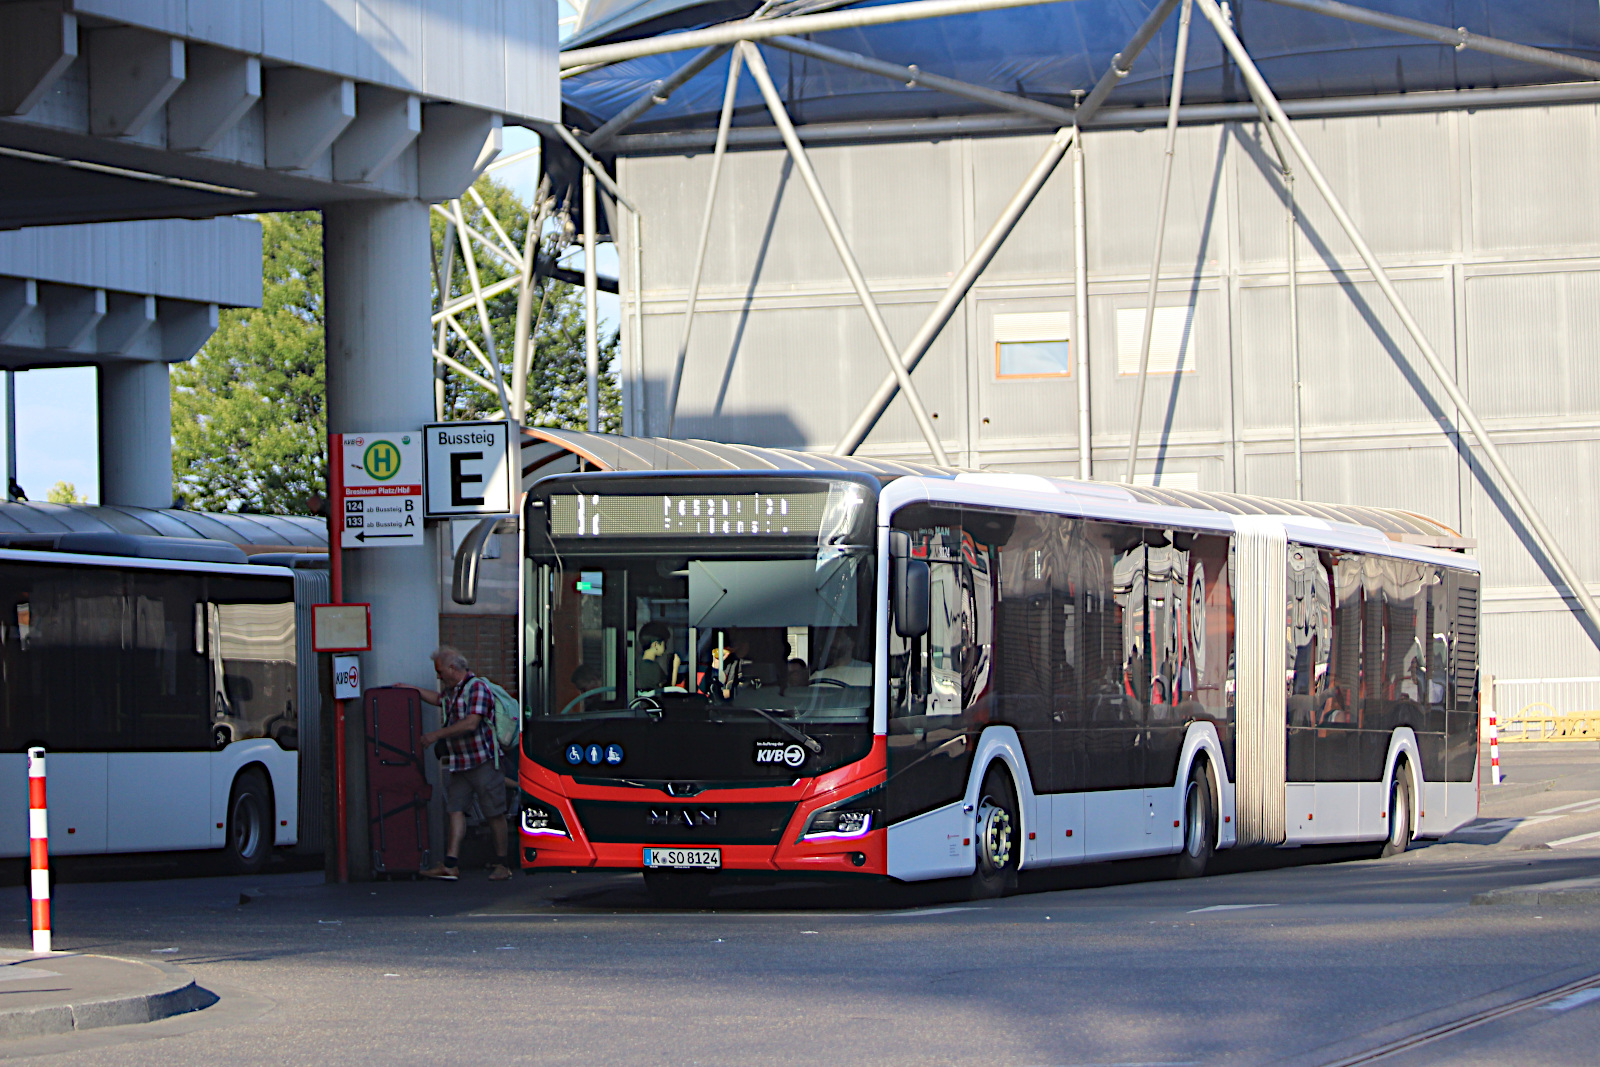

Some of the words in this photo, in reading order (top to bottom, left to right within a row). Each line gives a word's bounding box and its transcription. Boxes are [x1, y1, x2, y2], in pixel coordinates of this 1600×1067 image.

[438, 429, 495, 447] Bussteig
[373, 447, 391, 473] H
[450, 451, 484, 506] E
[345, 488, 377, 496] Breslauer
[346, 502, 363, 511] 124
[405, 499, 414, 512] B
[347, 517, 363, 526] 133
[404, 514, 415, 527] A
[935, 526, 950, 536] MAN
[939, 546, 950, 558] 8124
[336, 671, 349, 684] KVB
[756, 749, 784, 762] KVB
[647, 809, 718, 825] MAN
[652, 851, 660, 863] K
[668, 851, 684, 864] SO
[687, 851, 718, 864] 8124
